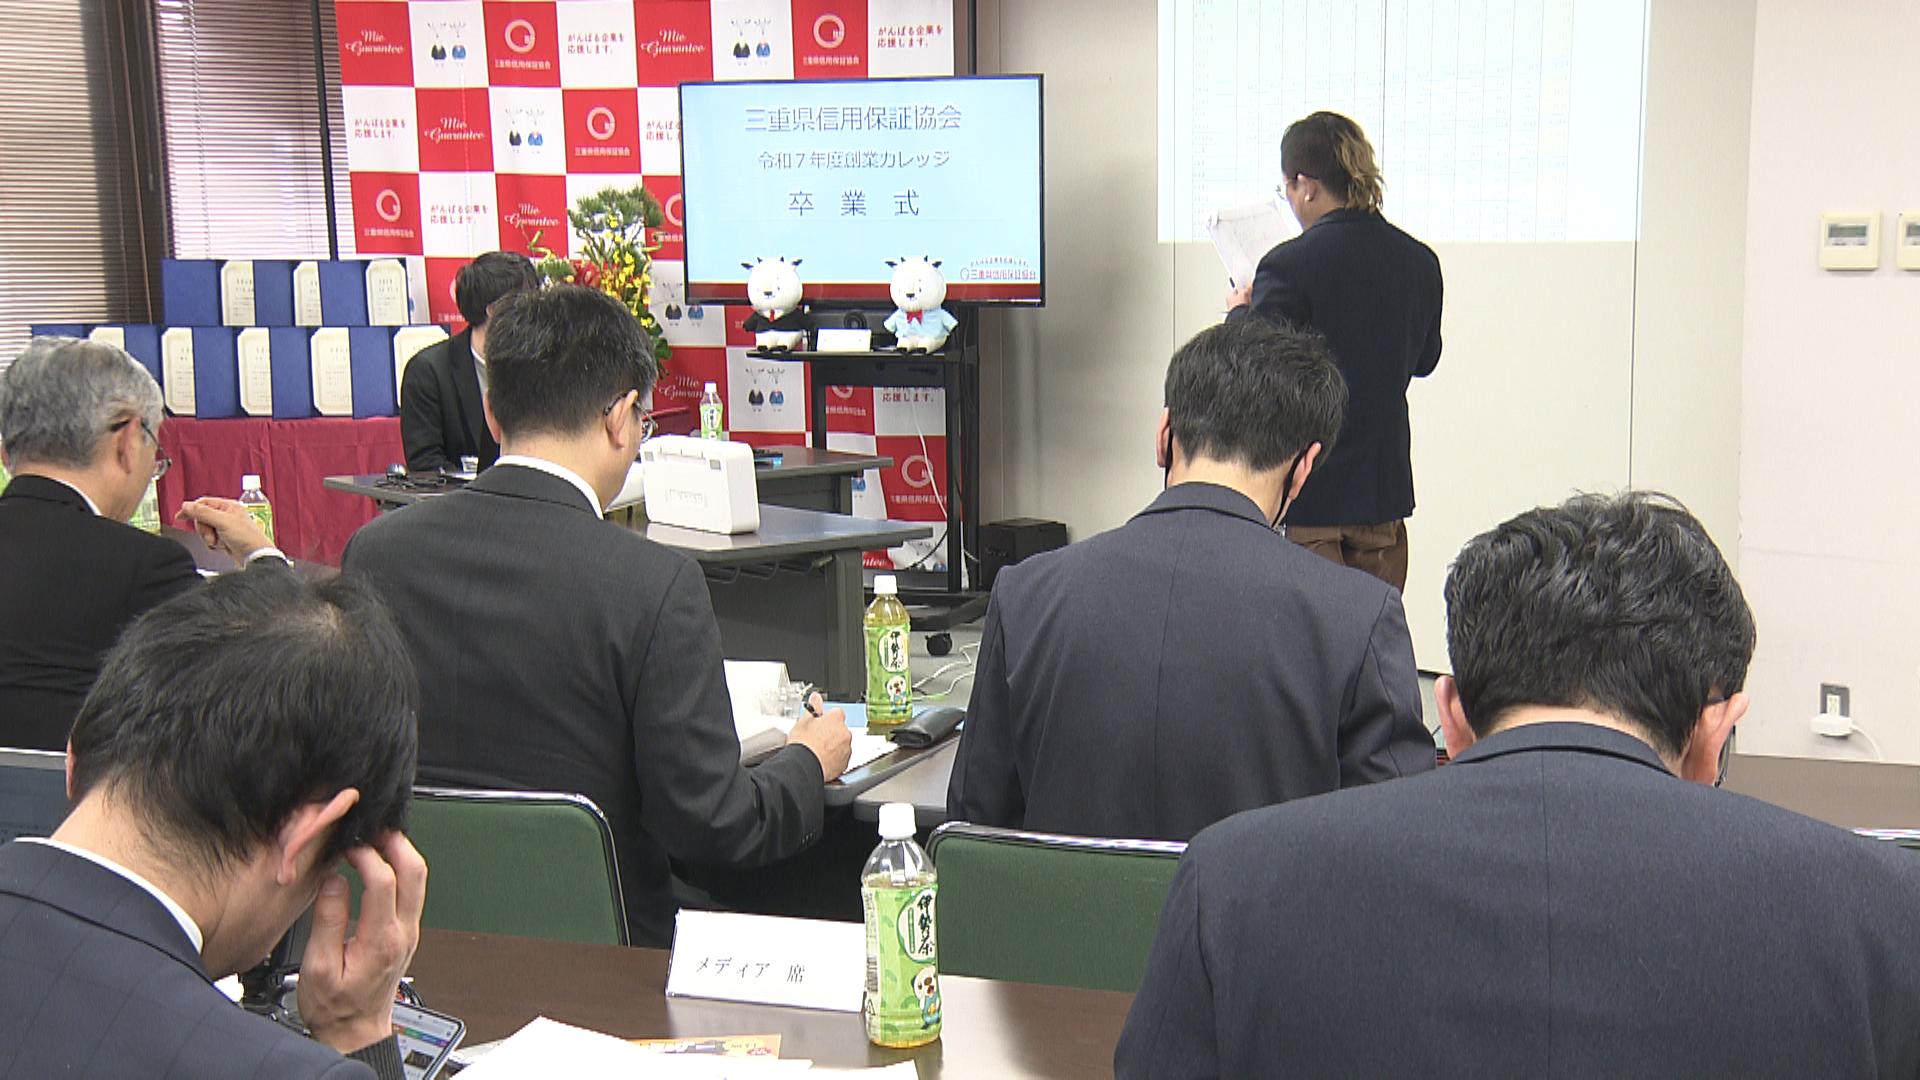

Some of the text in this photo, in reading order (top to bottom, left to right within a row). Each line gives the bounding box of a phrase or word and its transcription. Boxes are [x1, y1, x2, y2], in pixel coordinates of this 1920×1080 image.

[659, 29, 687, 42] Mie
[640, 40, 705, 58] Guarantee
[440, 116, 468, 129] Mie
[745, 104, 963, 132] 三重県信用保証協会
[424, 127, 484, 144] Guarantee
[788, 188, 920, 217] 卒 業 式
[696, 956, 806, 985] メディア 席
